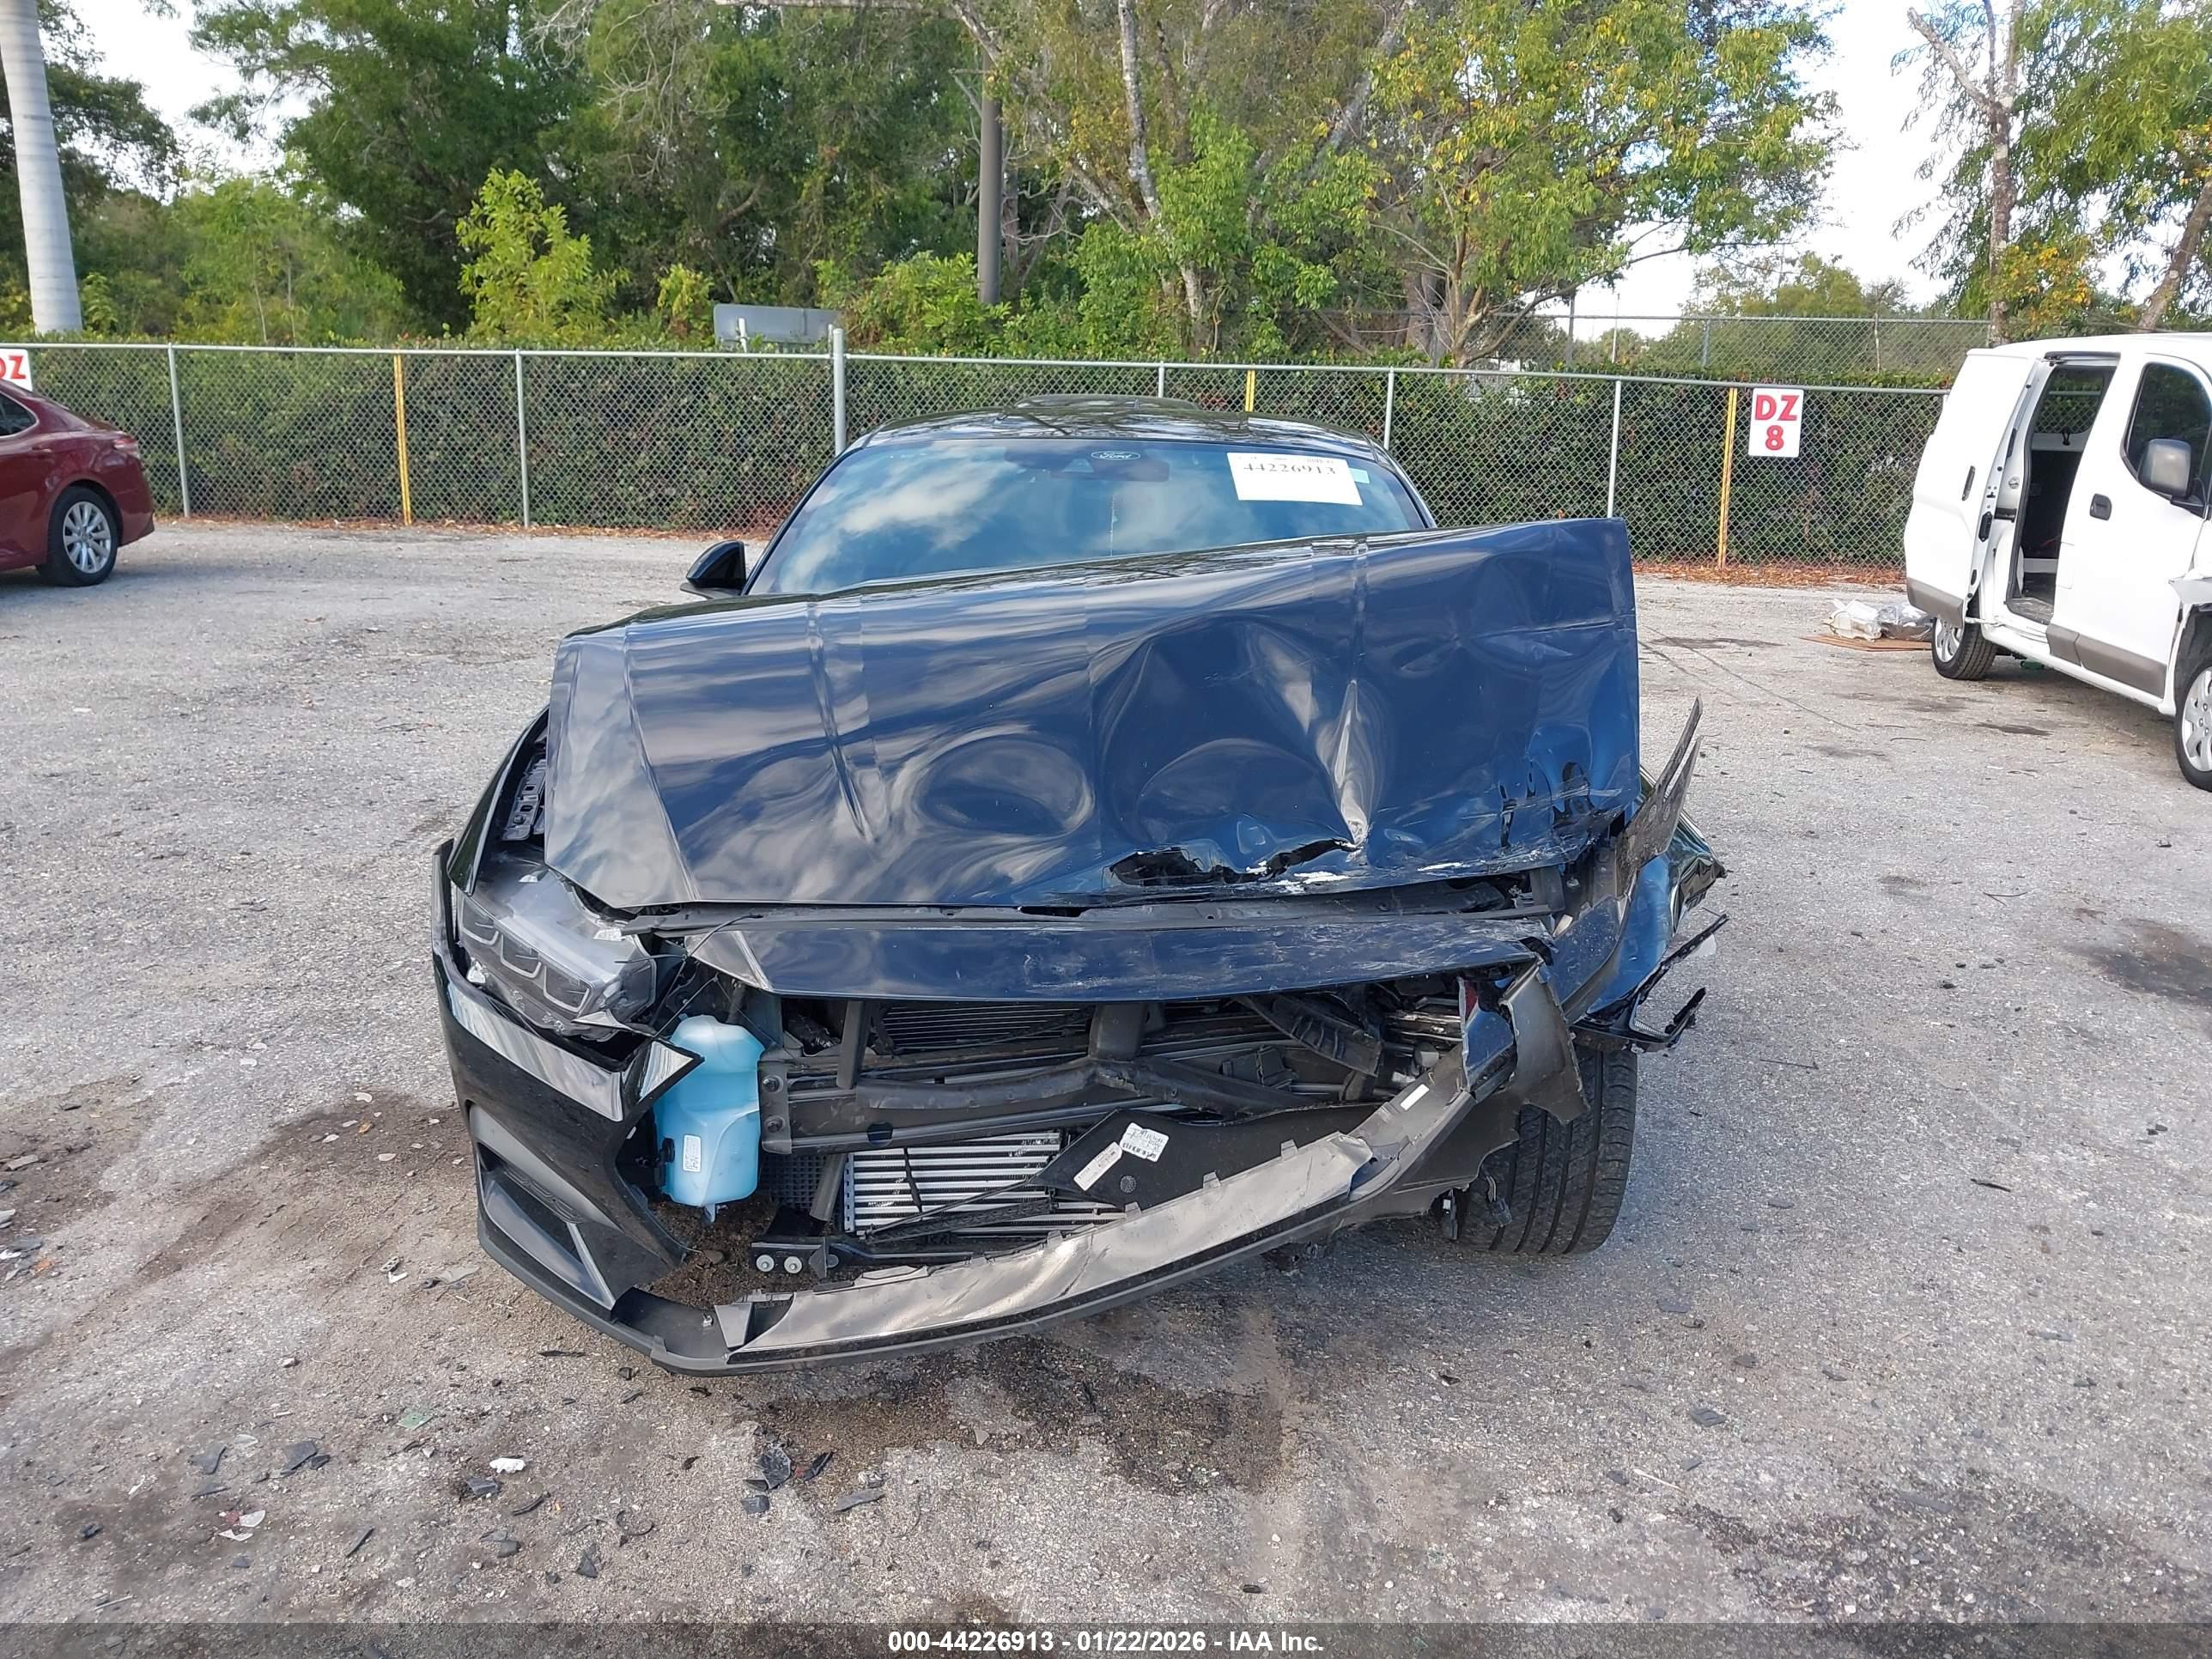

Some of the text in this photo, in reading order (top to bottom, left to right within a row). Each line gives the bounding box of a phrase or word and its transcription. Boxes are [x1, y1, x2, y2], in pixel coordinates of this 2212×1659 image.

[1754, 394, 1799, 421] DZ
[1765, 425, 1784, 451] 8
[1243, 462, 1336, 475] 44226913
